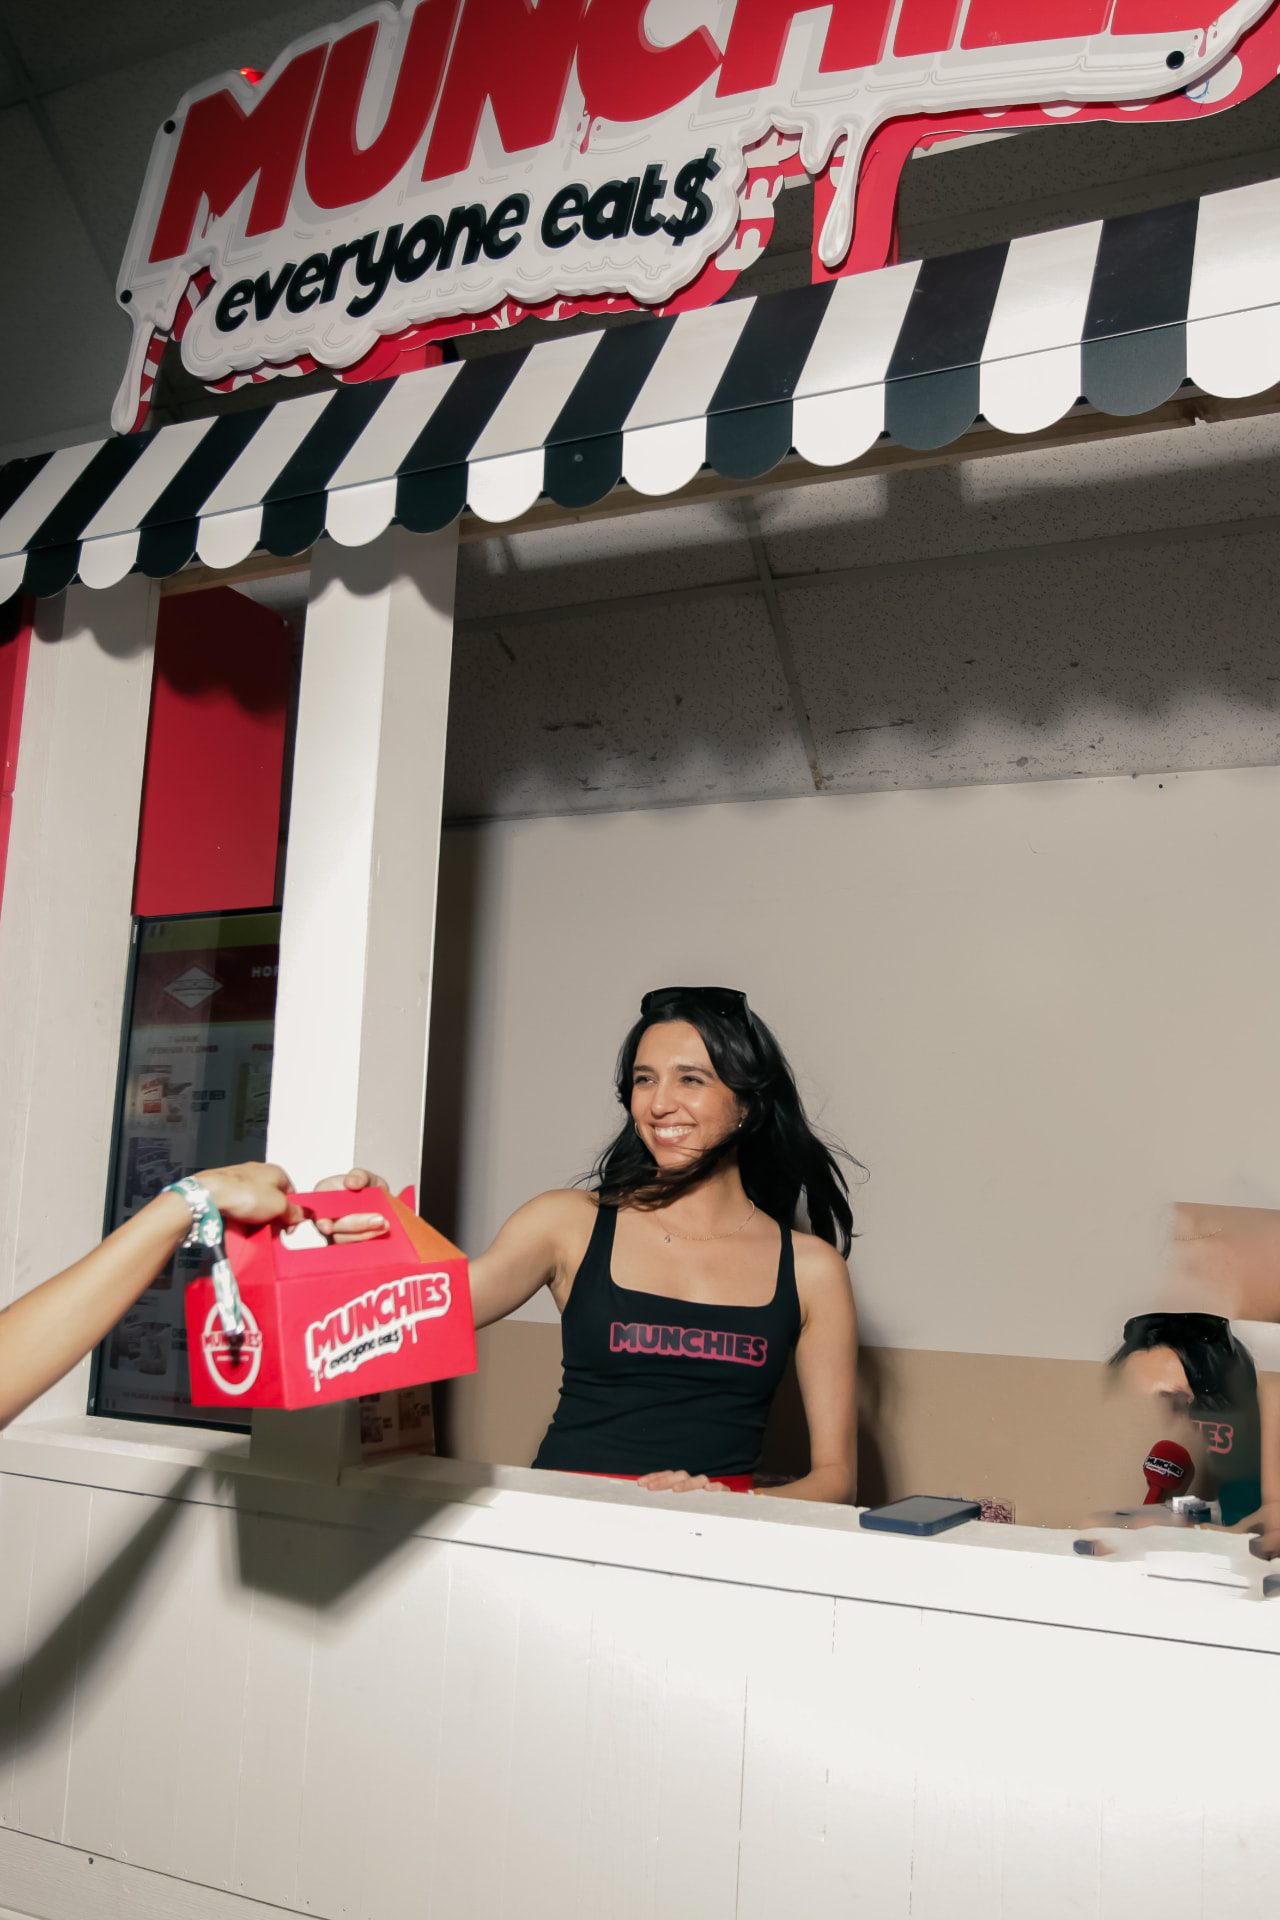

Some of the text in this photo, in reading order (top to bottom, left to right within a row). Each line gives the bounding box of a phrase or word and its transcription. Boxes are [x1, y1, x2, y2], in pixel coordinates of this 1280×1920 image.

[213, 147, 723, 332] everyone eat$
[308, 1275, 449, 1362] MUNCHIES
[610, 1322, 768, 1367] MUNCHIES
[1147, 1457, 1183, 1476] MUNCHIES
